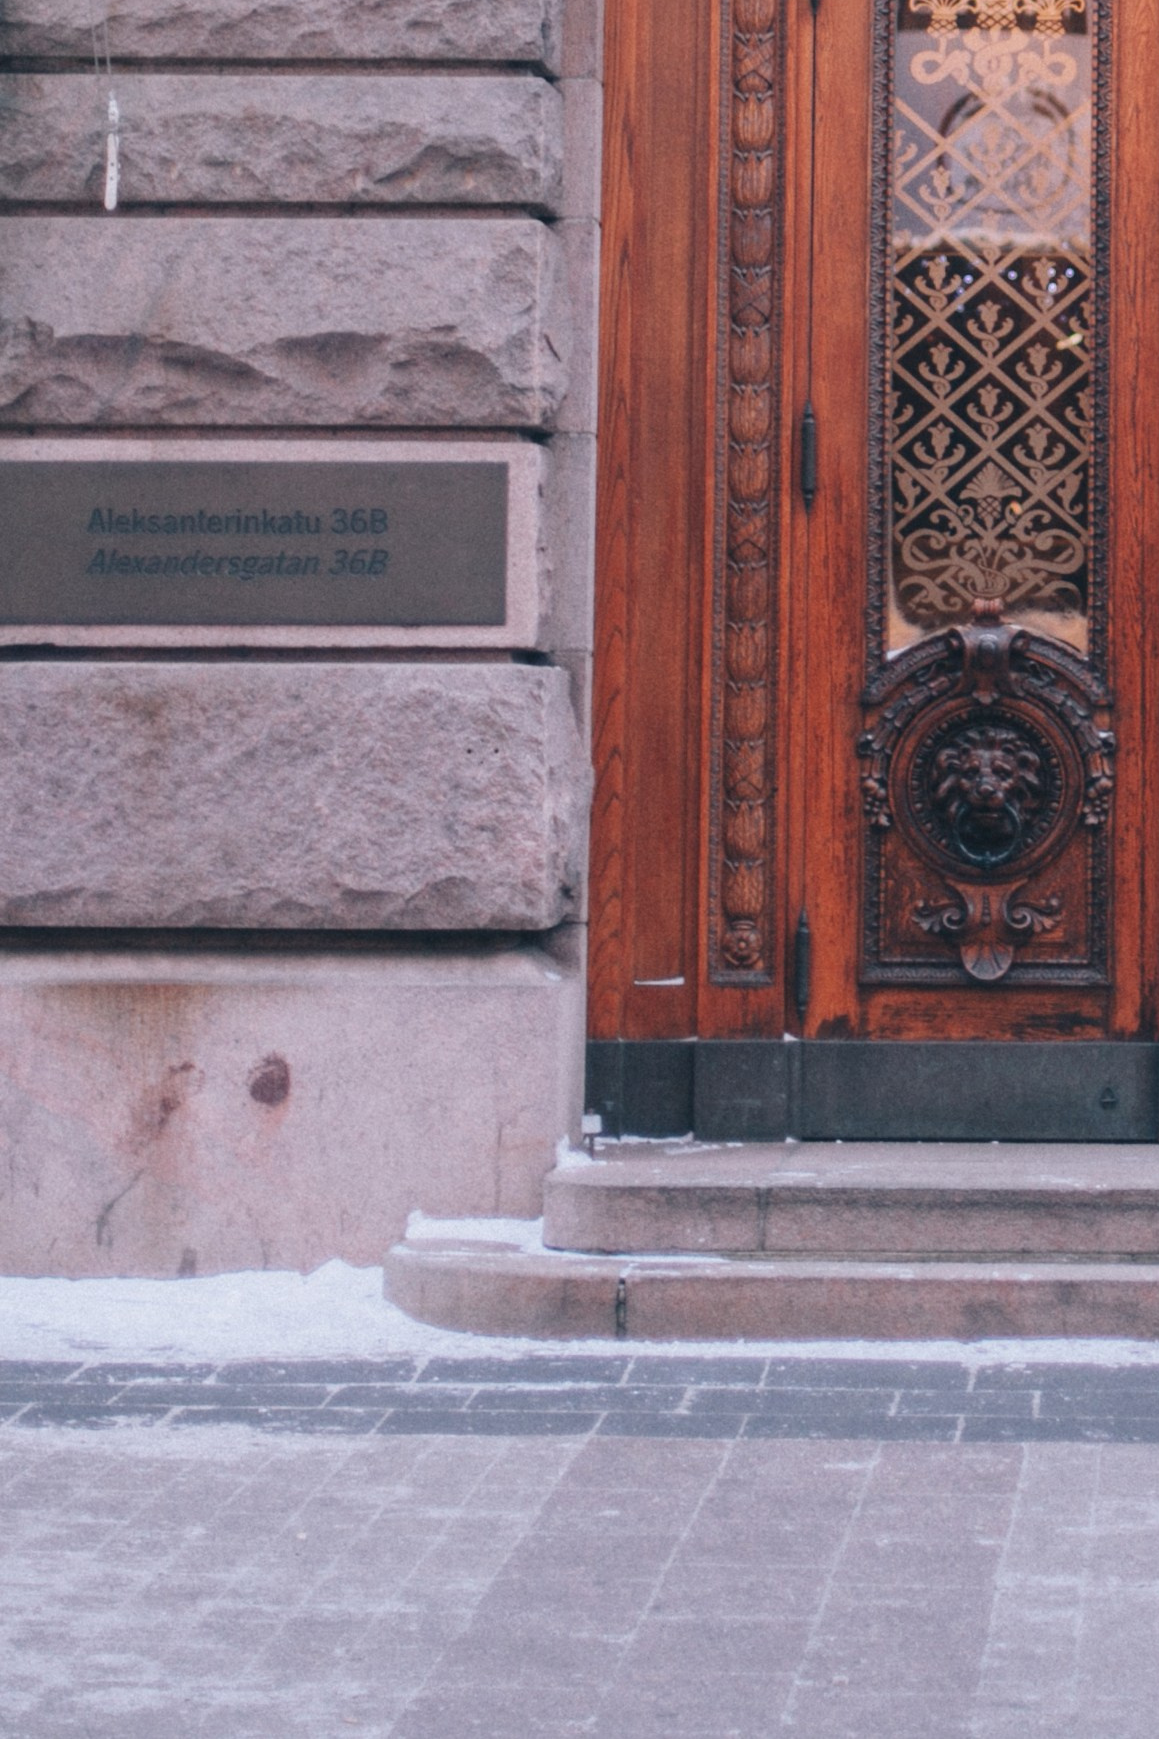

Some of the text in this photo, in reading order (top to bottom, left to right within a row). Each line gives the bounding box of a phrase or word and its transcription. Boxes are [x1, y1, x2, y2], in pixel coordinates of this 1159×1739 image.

[87, 508, 389, 535] Aleksanterinkatu 36B
[86, 548, 390, 581] Alexandersgatan 36B
